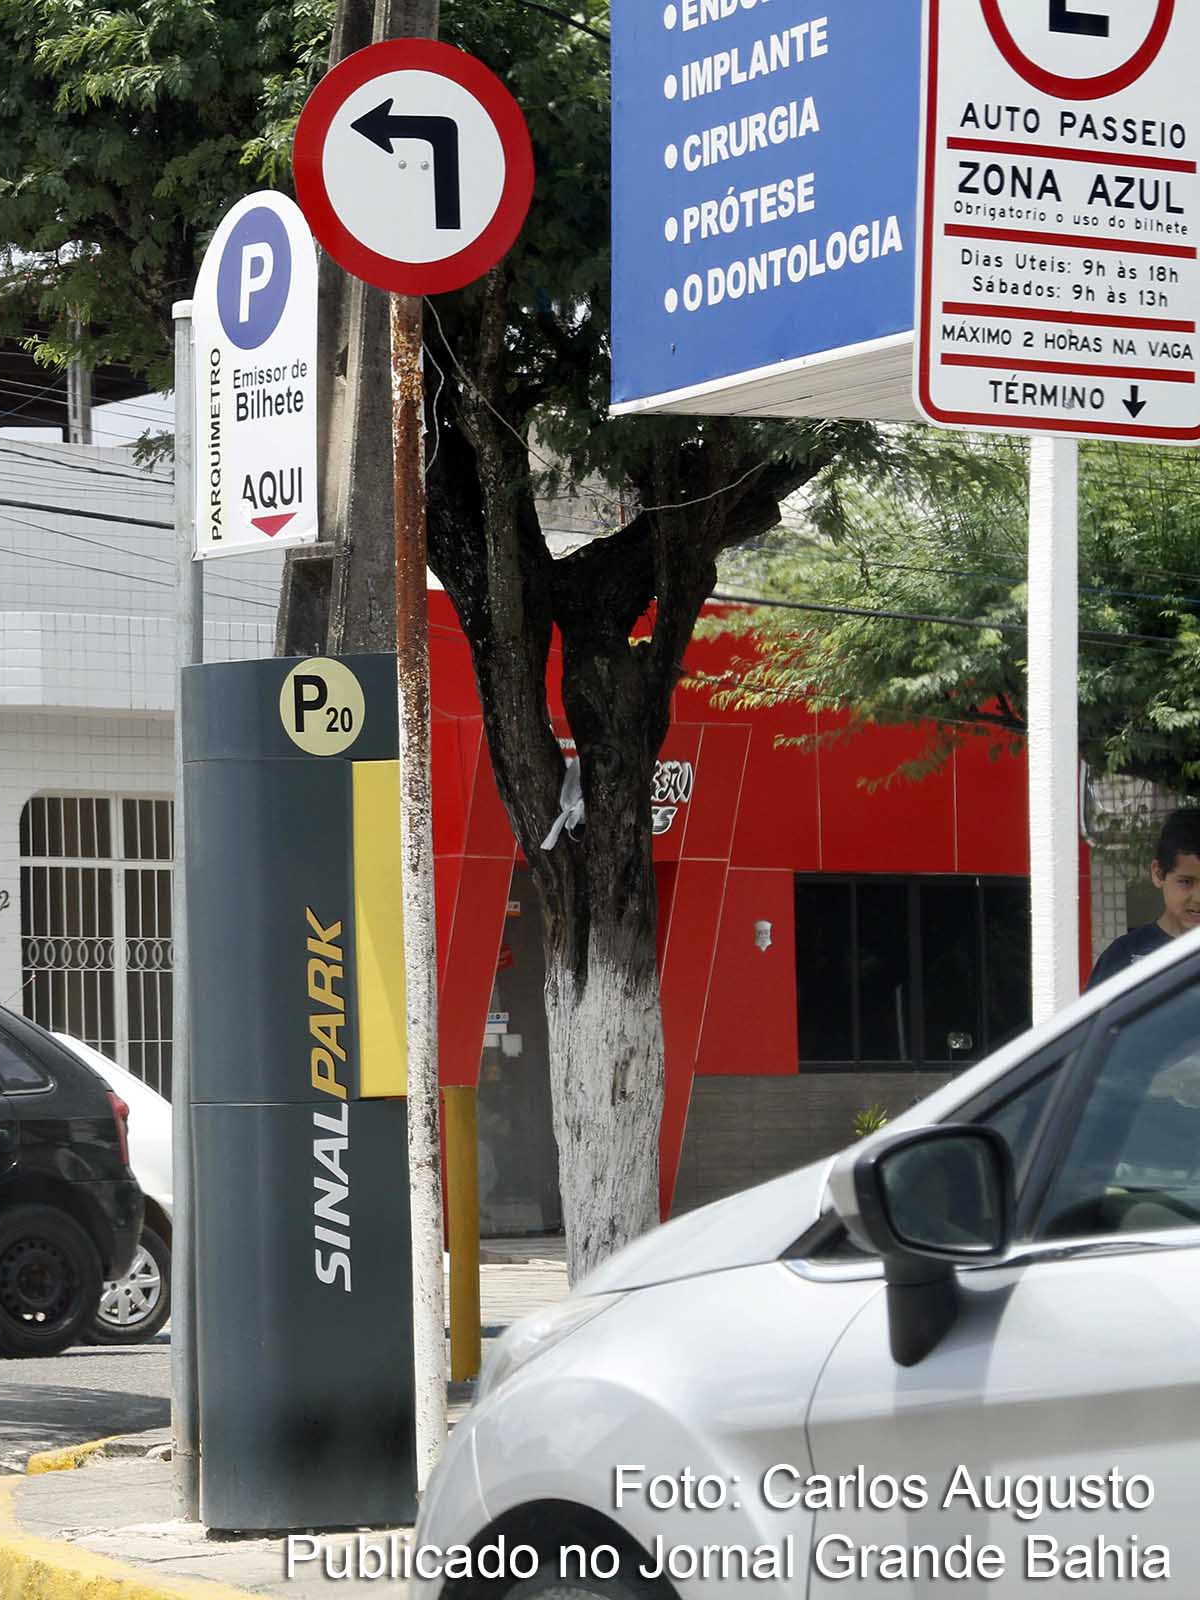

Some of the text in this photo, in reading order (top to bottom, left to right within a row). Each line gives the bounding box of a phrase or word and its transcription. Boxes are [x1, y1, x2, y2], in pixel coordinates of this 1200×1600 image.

[681, 16, 829, 101] IMPLANTE
[683, 96, 820, 171] CIRURGIA
[959, 102, 1186, 149] AUTO PASSEIO
[682, 172, 815, 245] PRÓTESE
[957, 161, 1185, 214] ZONA AZUL
[953, 200, 1189, 236] Obrigatorio o uso do bilhete
[239, 241, 274, 323] P
[682, 215, 903, 312] ODONTOLOGIA
[960, 248, 1179, 284] Dias Uteis: 9h às 18h
[972, 274, 1169, 308] Sábados: 9h às 13h
[941, 320, 1194, 360] MÁXIMO 2 HORAS NA VAGA
[232, 357, 308, 389] Emissor de
[988, 374, 1105, 410] TÉRMINO
[236, 386, 304, 422] Bilhete
[208, 347, 222, 541] PARQUÍMETRO
[241, 467, 303, 510] AQUI
